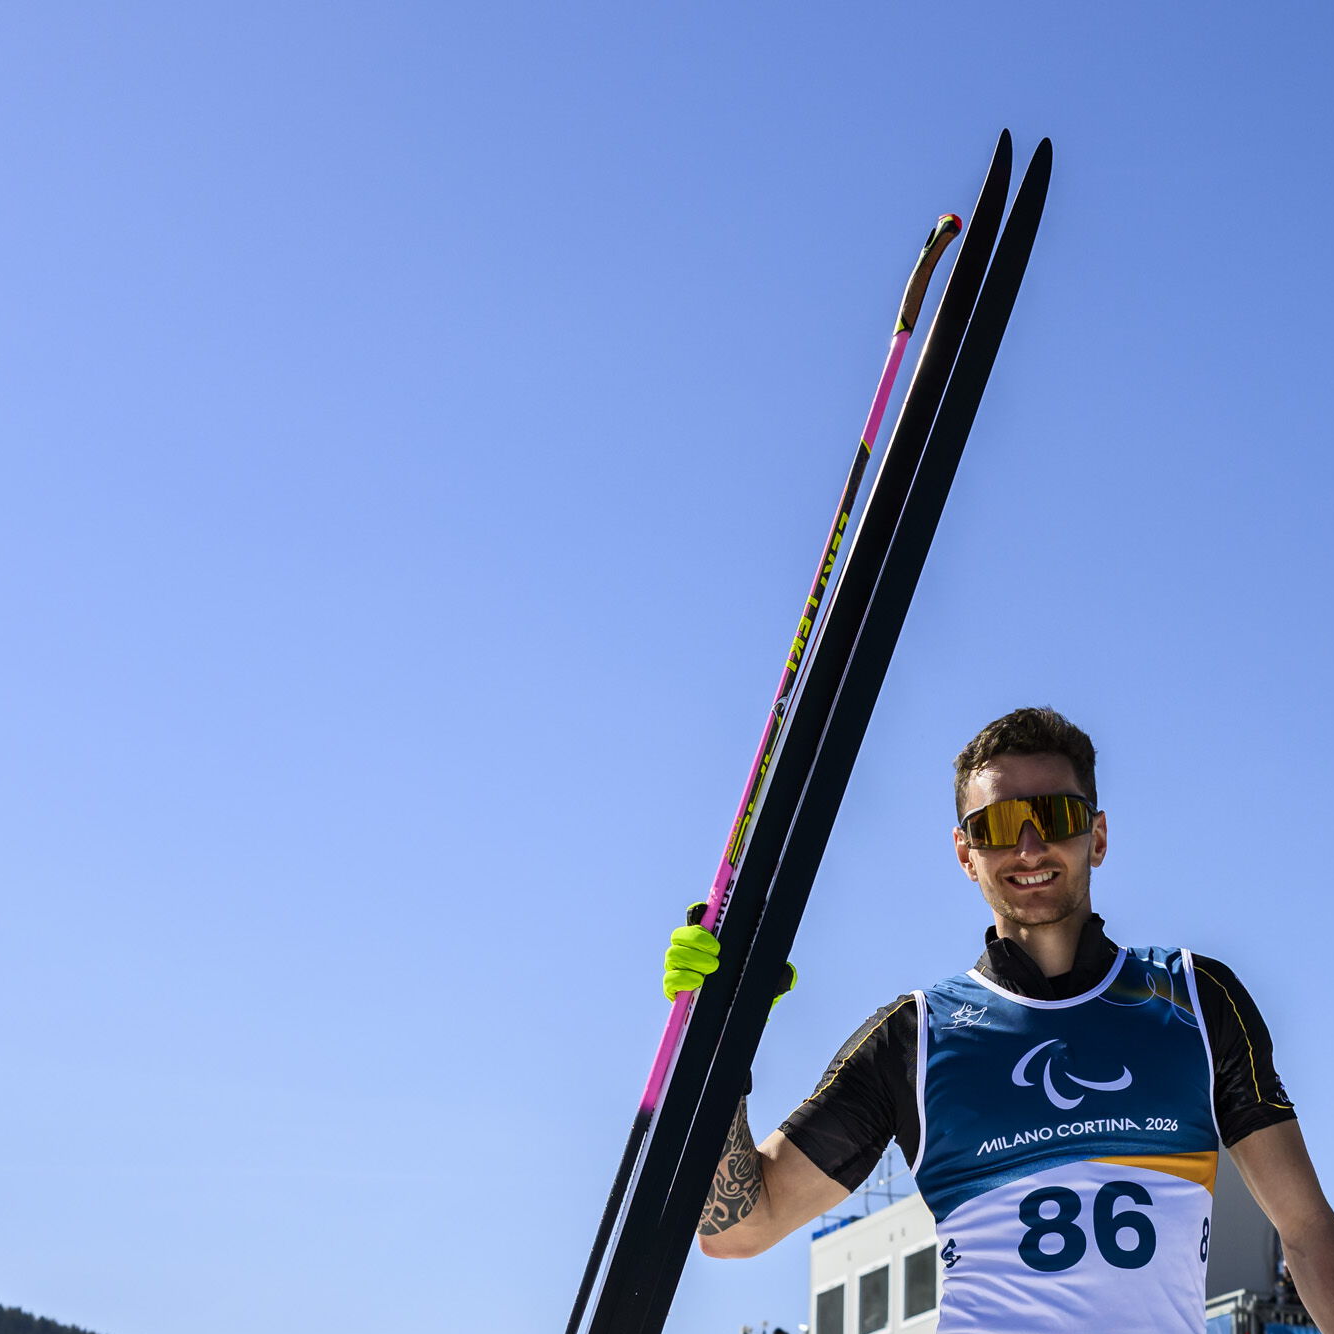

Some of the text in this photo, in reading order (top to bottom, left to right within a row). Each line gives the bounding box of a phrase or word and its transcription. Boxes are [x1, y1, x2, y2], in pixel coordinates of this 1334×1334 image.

[976, 1117, 1179, 1157] MILANO CORTINA 2026
[1017, 1180, 1157, 1273] 86
